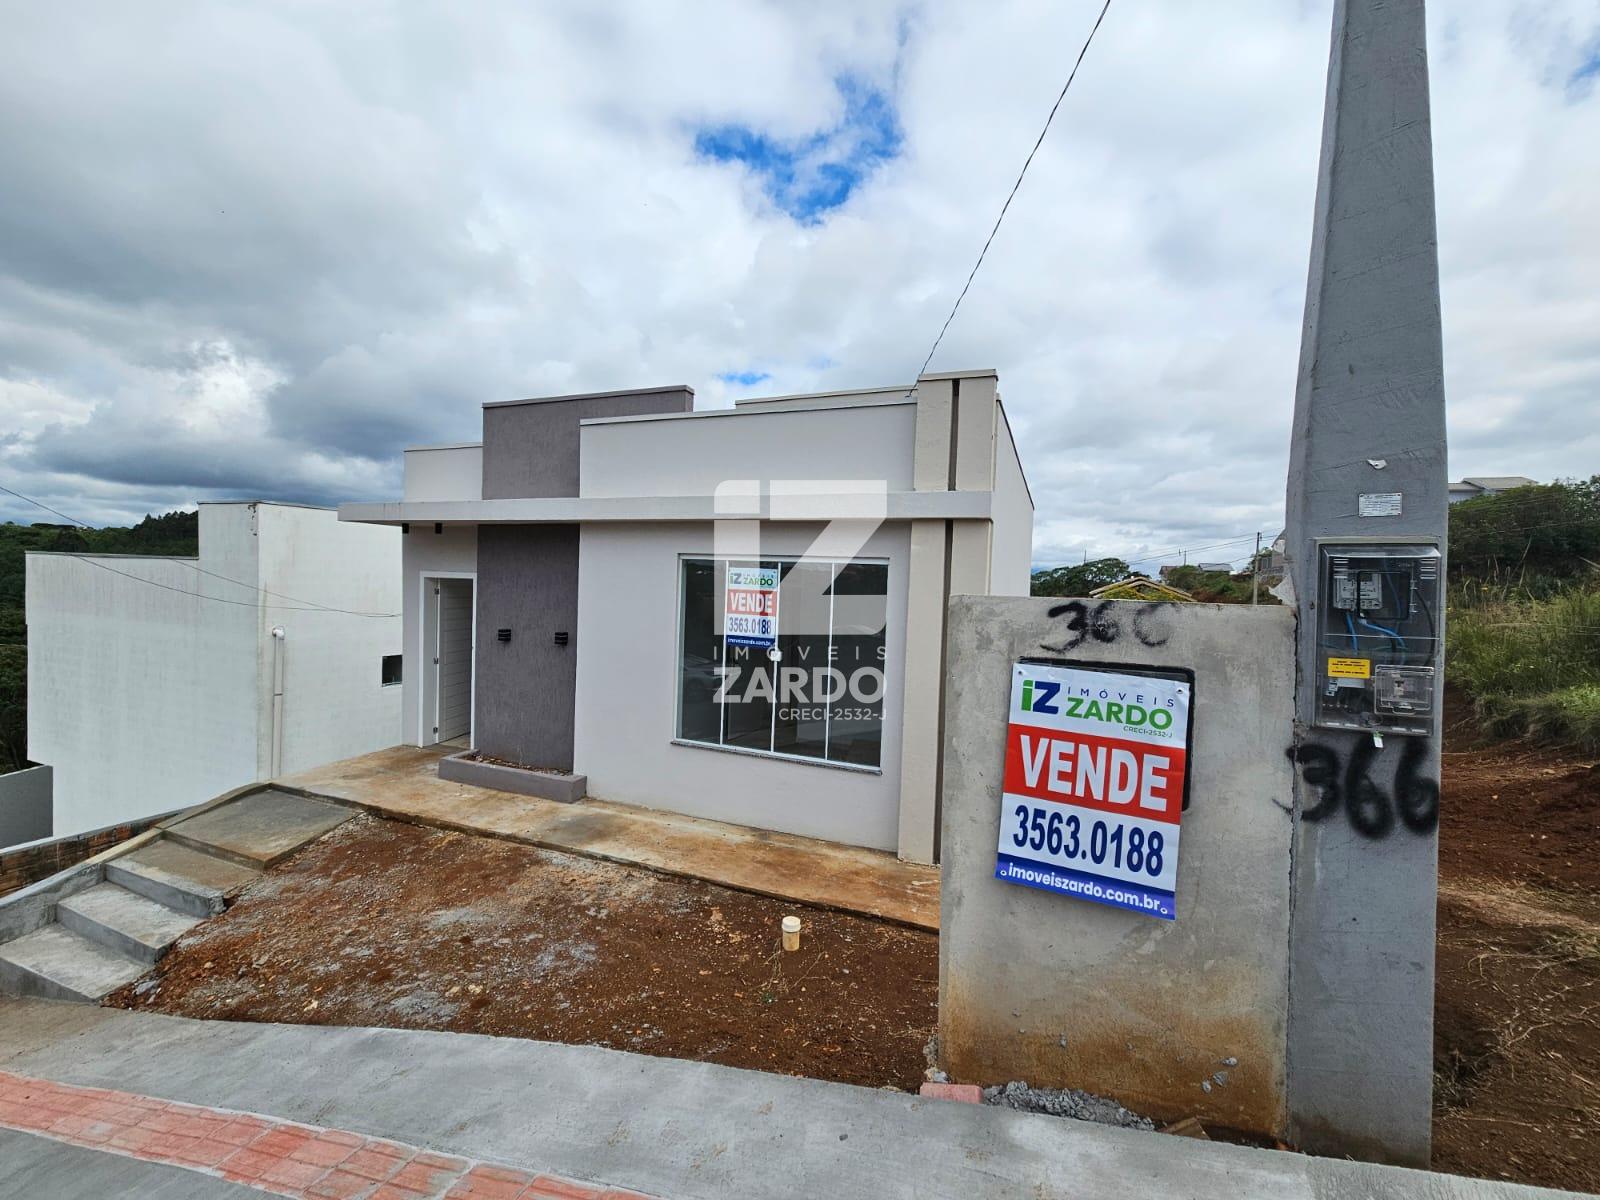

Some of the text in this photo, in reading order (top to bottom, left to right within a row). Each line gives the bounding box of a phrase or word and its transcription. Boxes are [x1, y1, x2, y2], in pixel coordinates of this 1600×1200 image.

[743, 577, 774, 586] ZARDO
[730, 592, 773, 614] VENDE
[729, 616, 772, 635] 3563.0188
[1067, 686, 1175, 708] IMÓVEIS
[1065, 697, 1173, 731] ZARDO
[1123, 725, 1173, 738] CRECI-2532-J
[1019, 734, 1171, 812] VENDE
[1273, 736, 1440, 840] 366
[1013, 804, 1165, 877] 3563.0188
[1008, 862, 1161, 911] imoveiszardo.com.br
